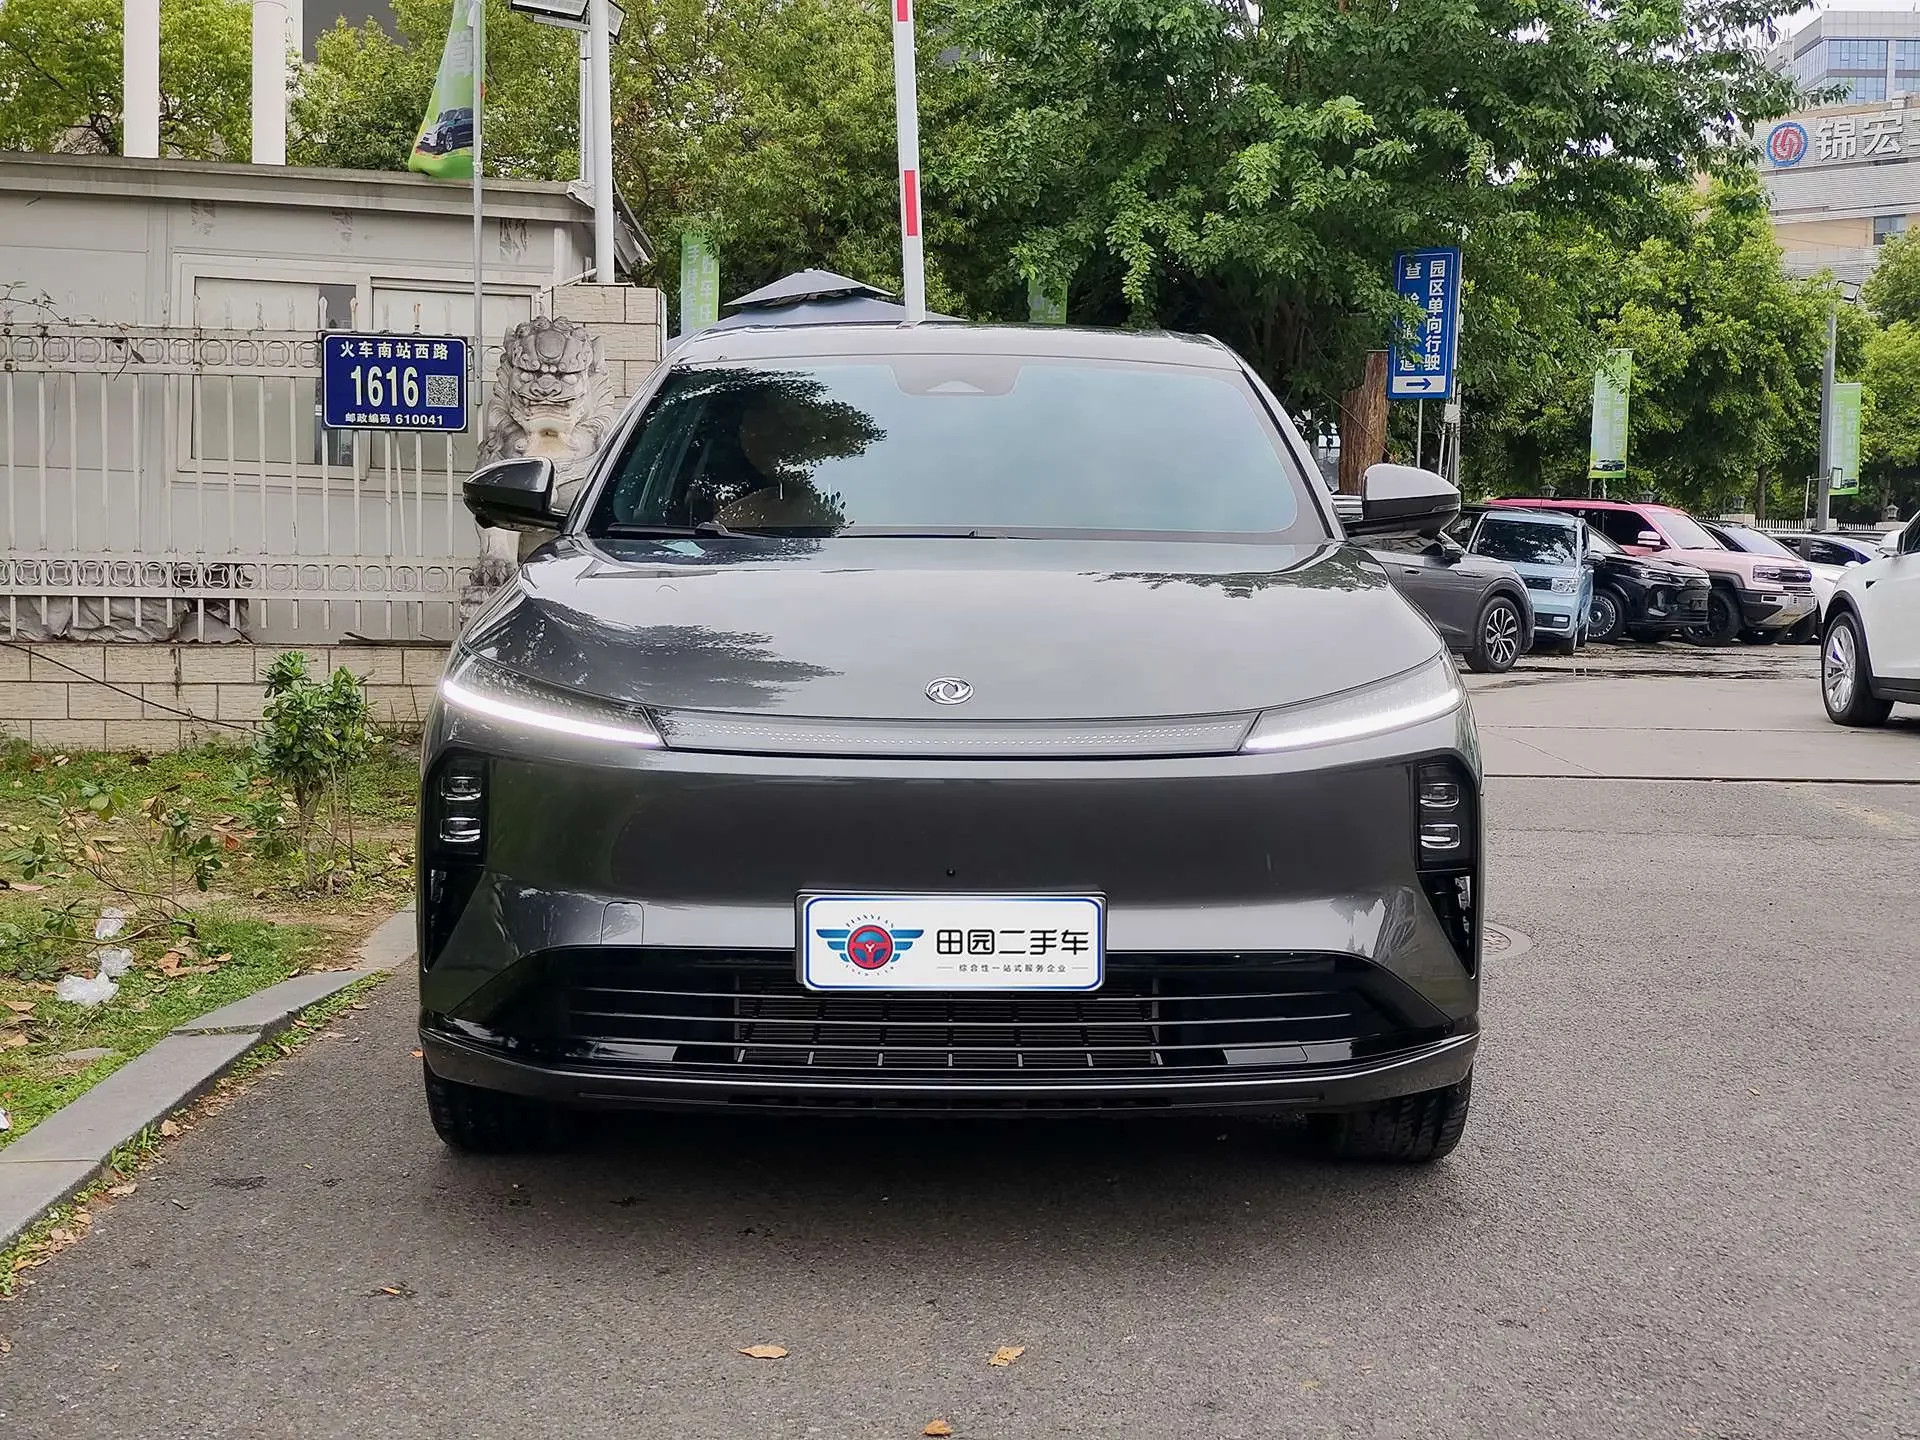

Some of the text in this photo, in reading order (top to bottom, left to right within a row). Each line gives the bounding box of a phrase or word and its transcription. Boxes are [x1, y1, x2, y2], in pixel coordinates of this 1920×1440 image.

[1424, 260, 1446, 371] 园区单向行驶
[340, 341, 449, 360] 火车南站西路
[351, 366, 419, 408] 1616
[345, 412, 443, 425] 邮政编码 610041
[937, 929, 1089, 955] 田园二手车
[959, 964, 1067, 973] 综合性一站式服务企业
